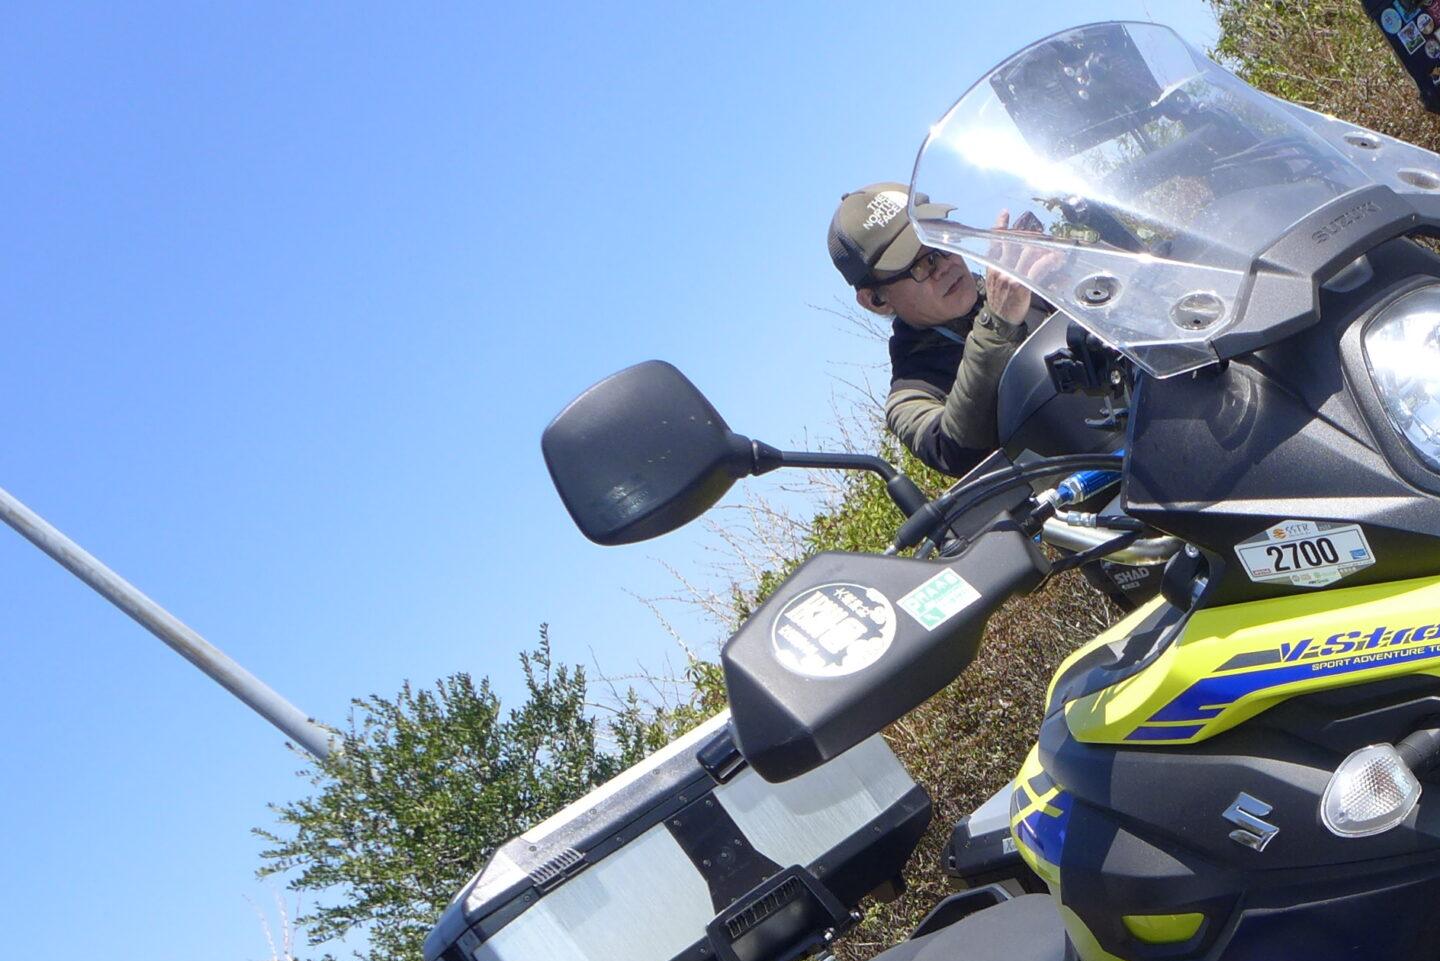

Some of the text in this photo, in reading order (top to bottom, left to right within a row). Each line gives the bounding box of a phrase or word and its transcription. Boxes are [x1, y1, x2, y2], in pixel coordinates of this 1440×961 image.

[863, 196, 895, 230] NORTH
[867, 193, 889, 211] THE
[877, 204, 902, 227] FACE
[1266, 537, 1339, 572] 2700
[1114, 567, 1149, 584] SHAD
[1312, 658, 1351, 671] SPORT
[1353, 647, 1425, 665] ADVENTURE
